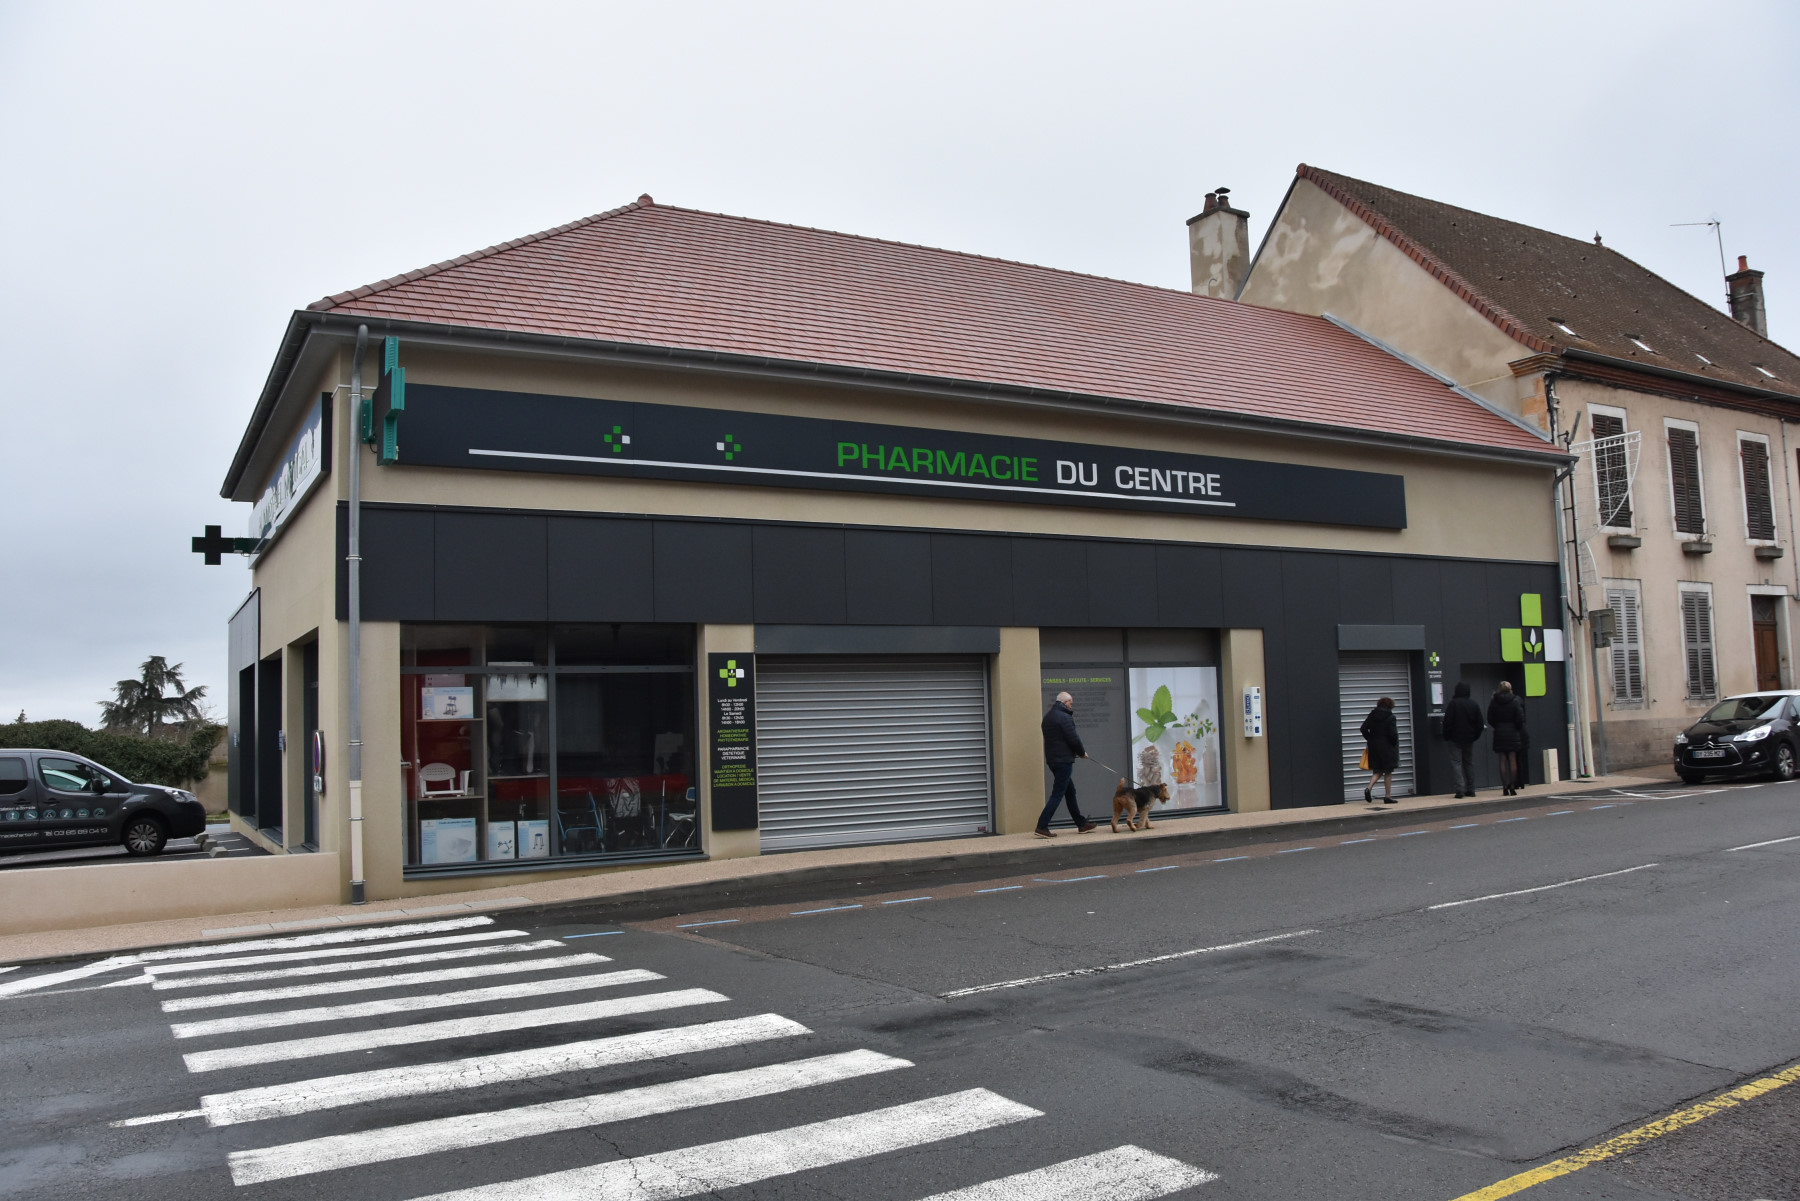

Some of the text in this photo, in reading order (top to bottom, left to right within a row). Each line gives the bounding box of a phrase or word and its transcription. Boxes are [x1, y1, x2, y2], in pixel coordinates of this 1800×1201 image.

[836, 441, 1222, 496] PHARMACIE DU CENTRE
